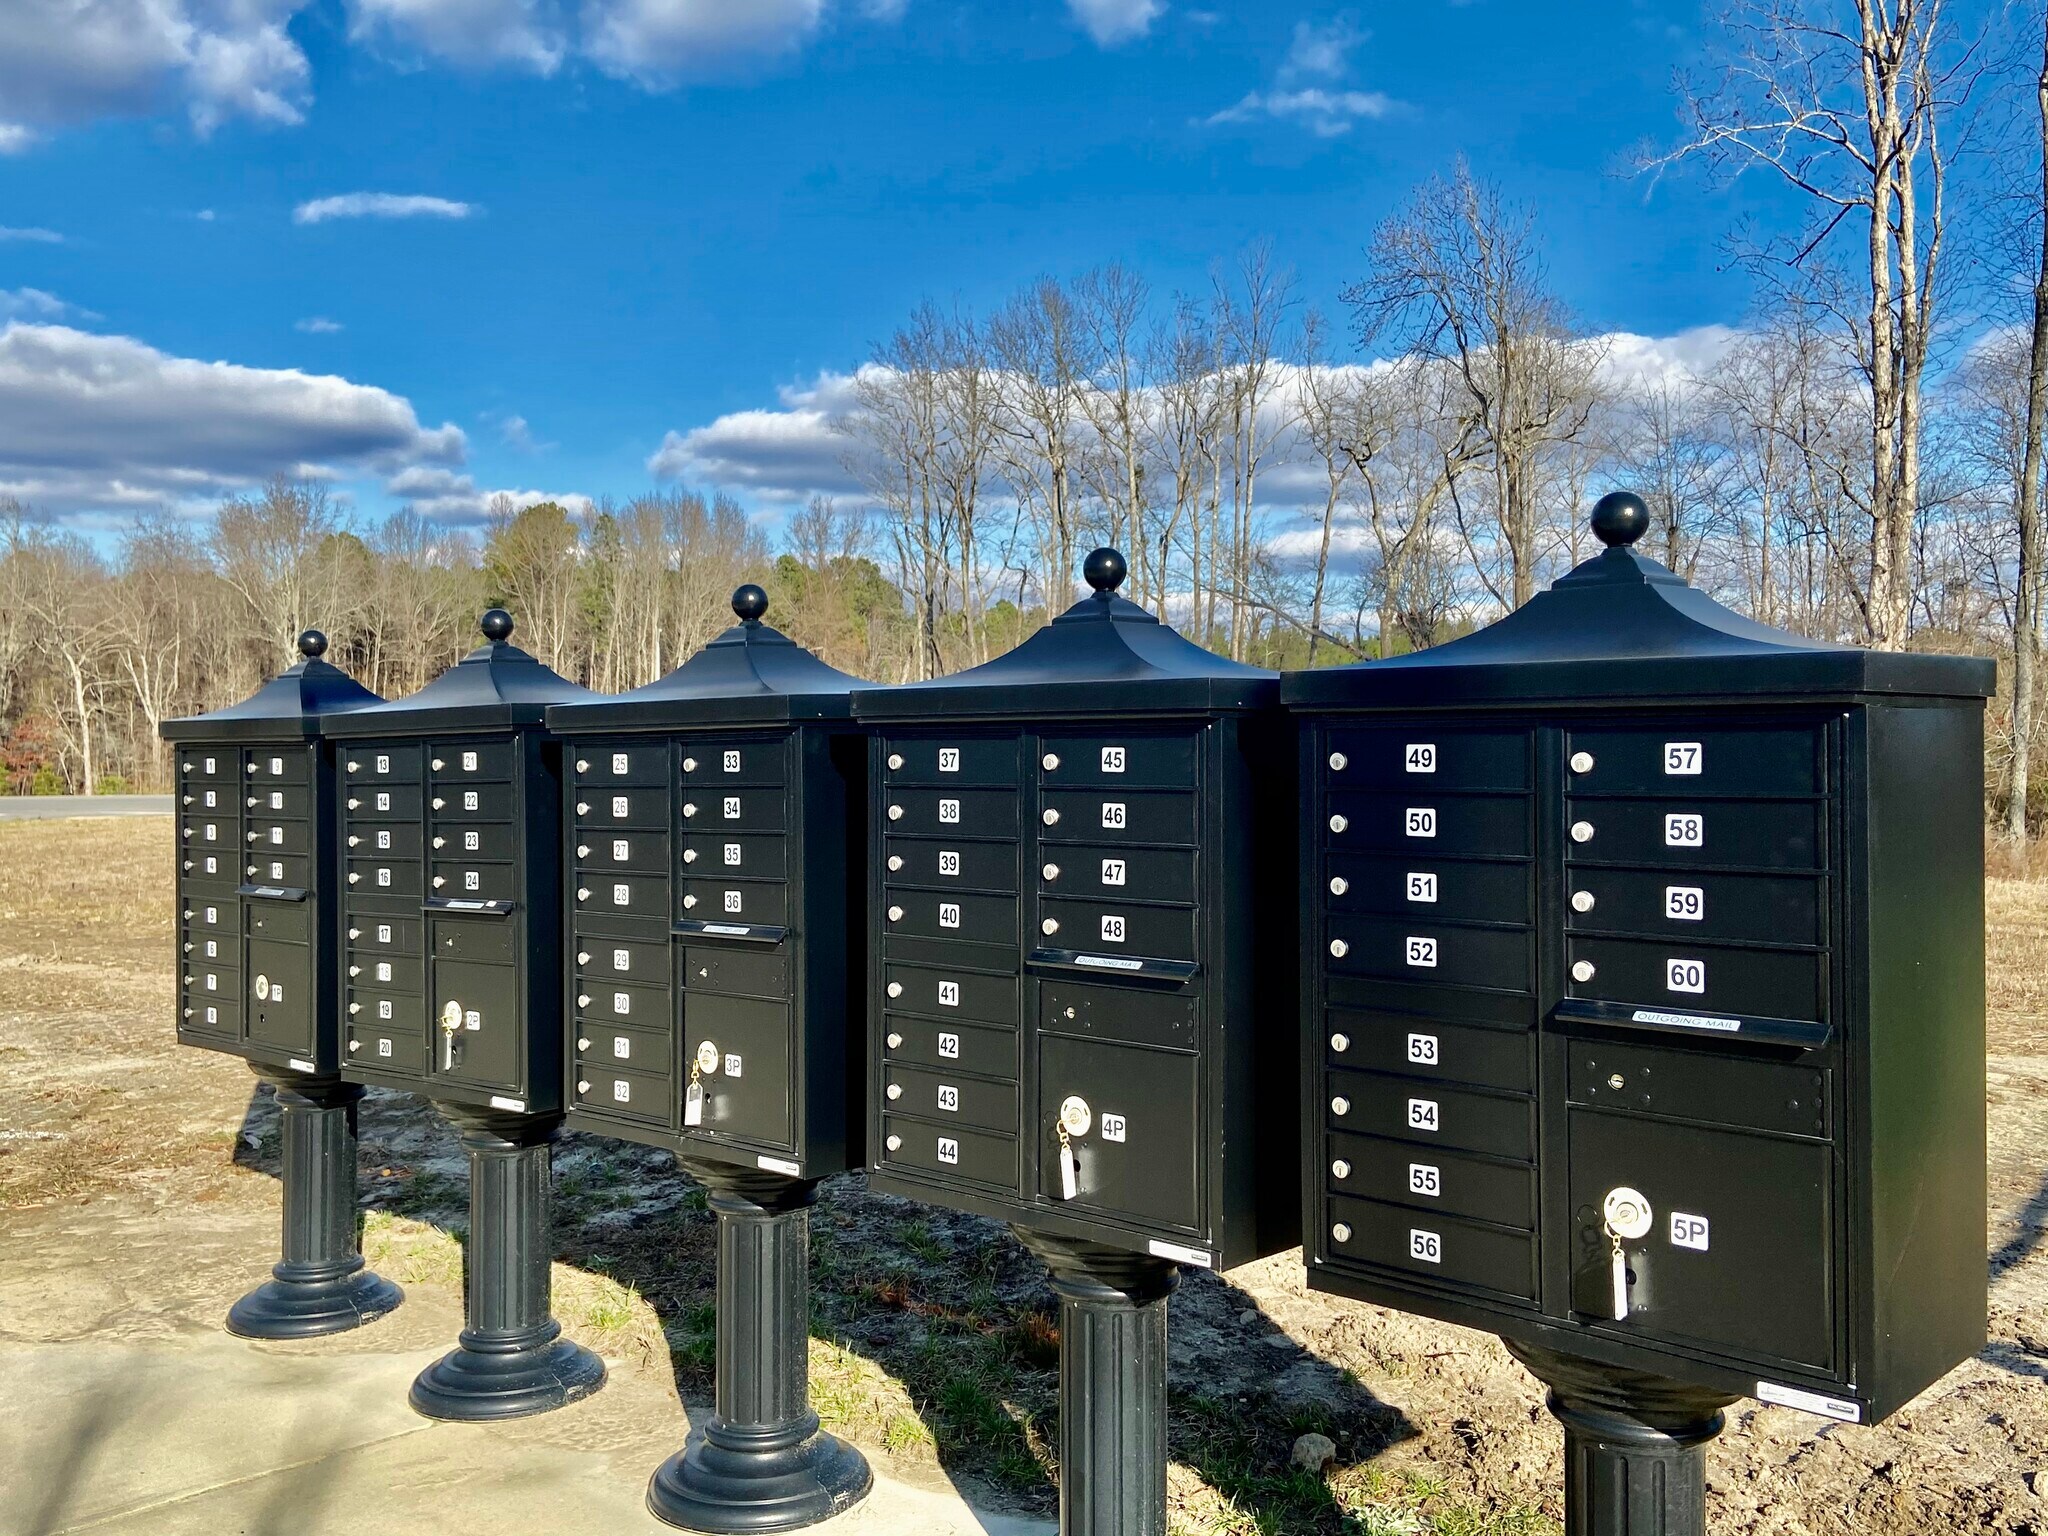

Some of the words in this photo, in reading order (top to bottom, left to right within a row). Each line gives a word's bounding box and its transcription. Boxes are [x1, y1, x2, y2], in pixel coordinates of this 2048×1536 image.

[378, 758, 388, 771] 13
[465, 755, 474, 768] 21
[614, 757, 626, 771] 25
[725, 754, 738, 769] 33
[941, 752, 957, 768] 37
[1103, 751, 1122, 769] 45
[1408, 748, 1433, 768] 49
[1668, 747, 1698, 770] 57
[208, 760, 213, 772] 1
[208, 793, 214, 805] 2
[273, 795, 282, 807] 10
[379, 796, 388, 808] 14
[466, 794, 476, 807] 22
[614, 800, 626, 814] 26
[725, 800, 738, 815] 34
[941, 803, 957, 820] 38
[1104, 806, 1123, 824] 46
[1409, 812, 1433, 833] 50
[274, 830, 282, 842] 11
[1669, 819, 1698, 841] 58
[380, 834, 388, 846] 15
[466, 834, 477, 847] 23
[615, 843, 626, 857] 27
[726, 847, 739, 862] 35
[209, 860, 214, 870] 4
[273, 865, 282, 877] 12
[941, 855, 957, 872] 39
[380, 871, 389, 884] 16
[1104, 863, 1123, 881] 47
[467, 874, 478, 887] 24
[1410, 877, 1432, 898] 51
[615, 888, 627, 902] 28
[726, 894, 739, 909] 36
[1670, 892, 1699, 915] 59
[210, 910, 214, 921] 5
[941, 907, 957, 924] 40
[380, 928, 389, 940] 17
[1103, 920, 1122, 938] 48
[1409, 941, 1434, 962] 52
[616, 953, 627, 967] 29
[380, 965, 390, 978] 18
[1670, 964, 1700, 988] 60
[210, 976, 214, 987] 7
[273, 987, 282, 1000] 1P
[940, 985, 955, 1002] 41
[381, 1004, 390, 1016] 19
[616, 996, 628, 1011] 30
[468, 1013, 479, 1028] 2P
[1637, 1012, 1701, 1026] OUTGOING
[1705, 1020, 1734, 1029] MAIL
[380, 1041, 390, 1054] 20
[616, 1040, 627, 1054] 31
[940, 1036, 956, 1054] 42
[1411, 1038, 1435, 1060] 53
[726, 1058, 740, 1073] 3P
[616, 1084, 628, 1099] 32
[939, 1090, 956, 1107] 43
[1411, 1103, 1436, 1126] 54
[1103, 1118, 1124, 1136] 4P
[939, 1142, 956, 1160] 44
[1412, 1168, 1437, 1191] 55
[1673, 1218, 1706, 1243] 5P
[1413, 1234, 1437, 1257] 56
